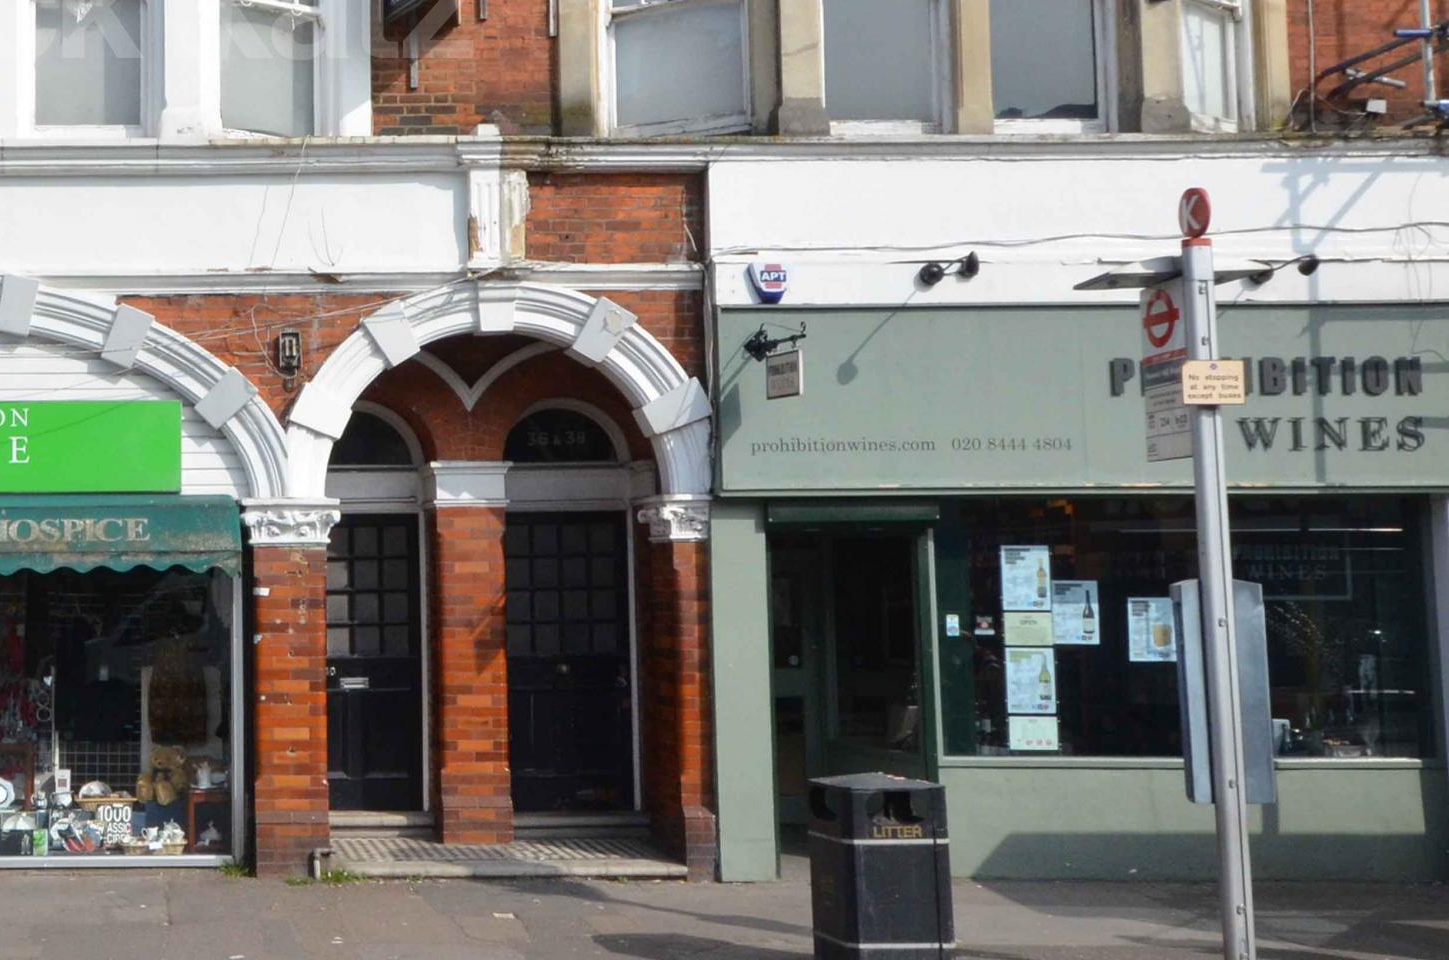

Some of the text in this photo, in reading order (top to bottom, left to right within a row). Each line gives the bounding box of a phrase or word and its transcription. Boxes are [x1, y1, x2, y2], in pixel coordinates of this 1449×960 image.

[1181, 194, 1201, 233] K
[761, 271, 786, 282] APT
[1109, 357, 1423, 396] PIBITION
[1205, 374, 1239, 383] stopping
[1203, 384, 1216, 392] any
[1188, 392, 1213, 401] except
[1219, 391, 1241, 399] buses
[1236, 416, 1426, 452] WINES
[750, 436, 1072, 457] prohibitionwines.com 020 8444 4804
[872, 825, 923, 838] LITTER
